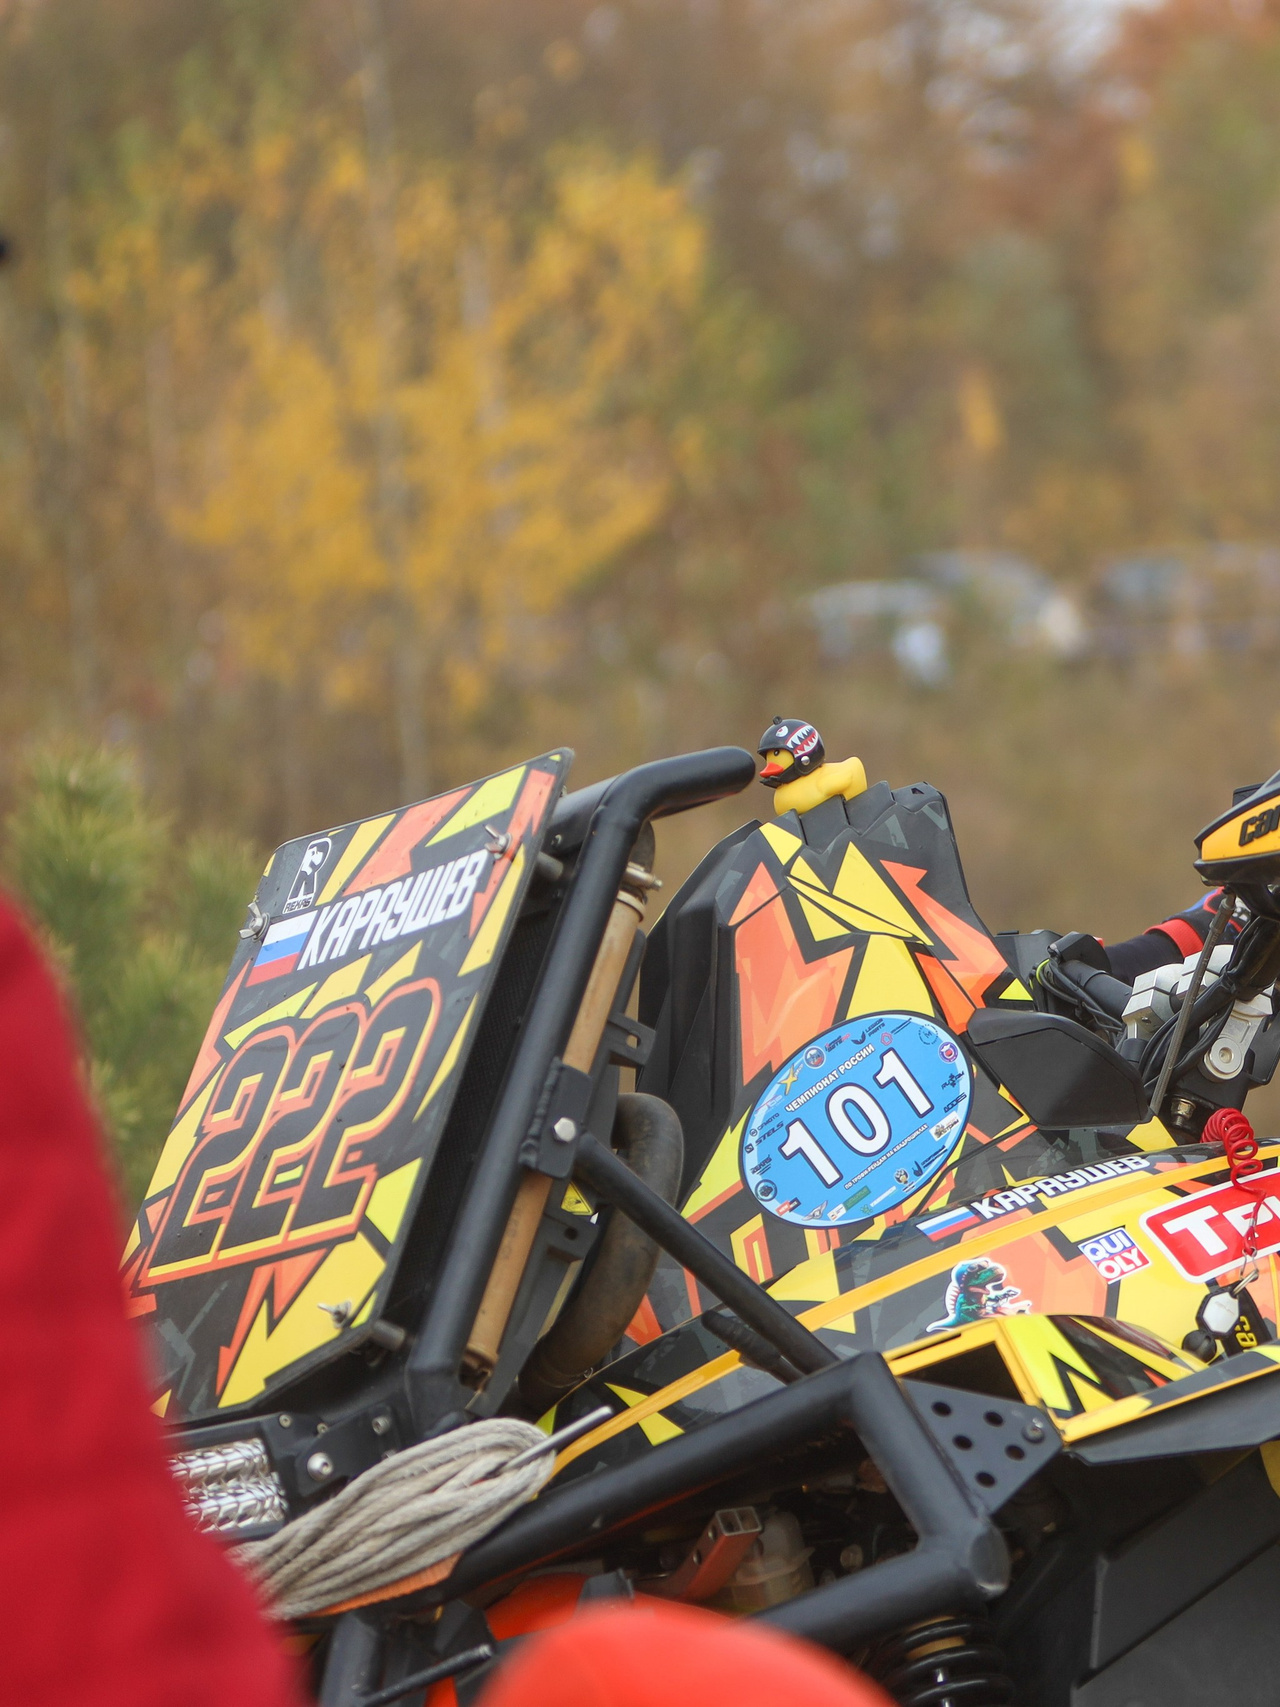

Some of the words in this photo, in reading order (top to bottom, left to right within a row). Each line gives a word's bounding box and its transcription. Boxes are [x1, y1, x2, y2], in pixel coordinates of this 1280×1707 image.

[785, 1070, 839, 1113] ЧЕМПИОНАТ
[839, 1043, 875, 1075] РОССИИ
[143, 980, 439, 1284] 222
[753, 1121, 786, 1146] STELS
[779, 1048, 934, 1188] 101
[970, 1156, 1150, 1219] КАРАУШЕВ
[1083, 1231, 1133, 1262] QUI
[1098, 1247, 1142, 1279] OLY
